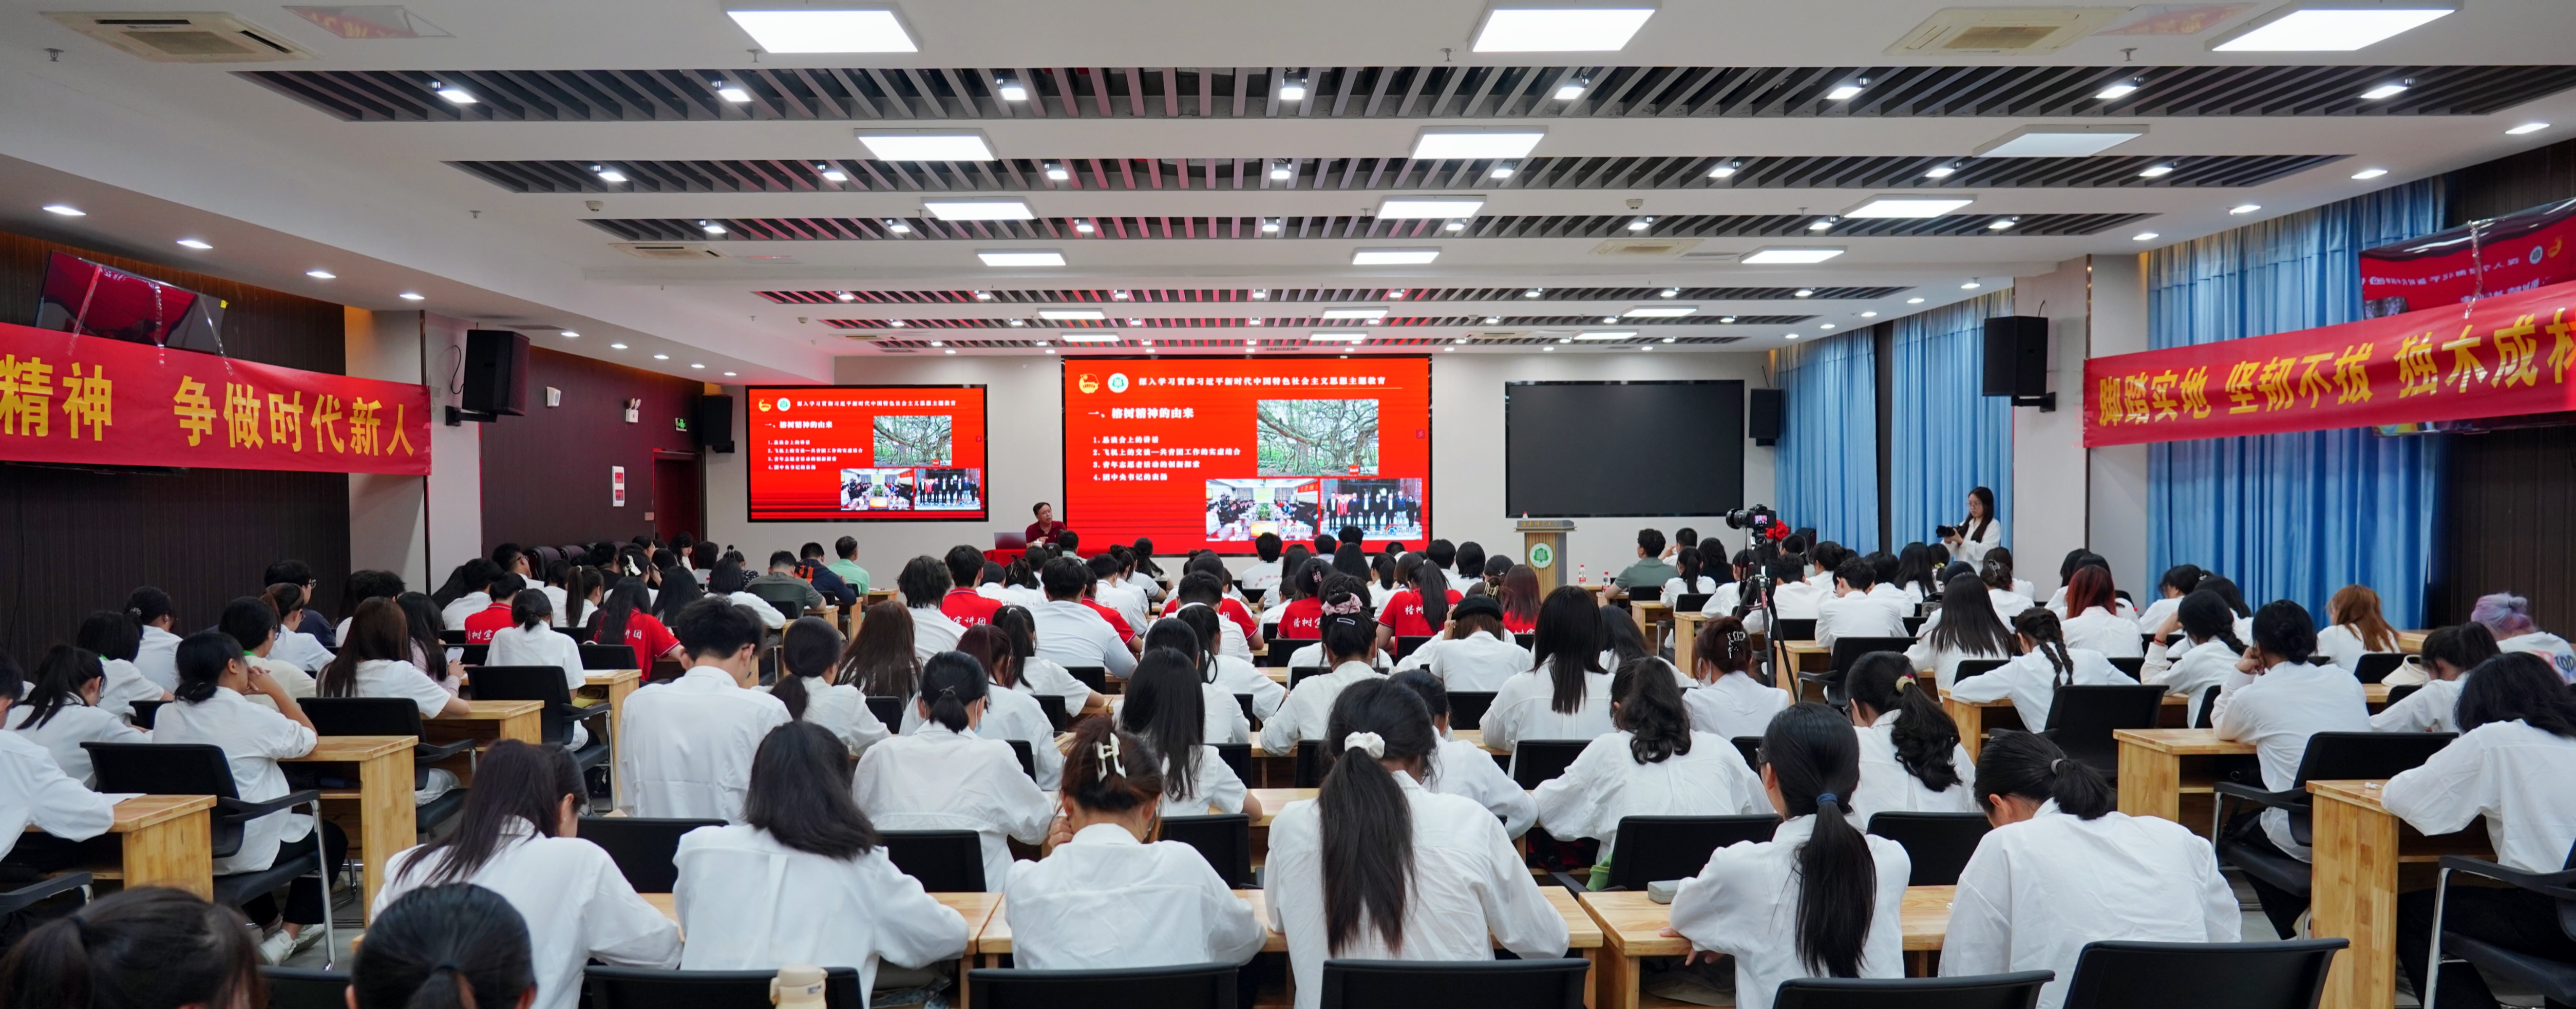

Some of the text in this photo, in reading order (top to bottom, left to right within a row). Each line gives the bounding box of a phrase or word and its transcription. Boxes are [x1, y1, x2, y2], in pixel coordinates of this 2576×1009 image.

[0, 354, 414, 457] 精神 争做时代新人
[1139, 376, 1386, 386] 深入学习贯彻习近平新时代中国特色社会主义思想主题教育
[2099, 365, 2211, 427] 脚踏实地
[2226, 342, 2373, 415] 坚韧不拔
